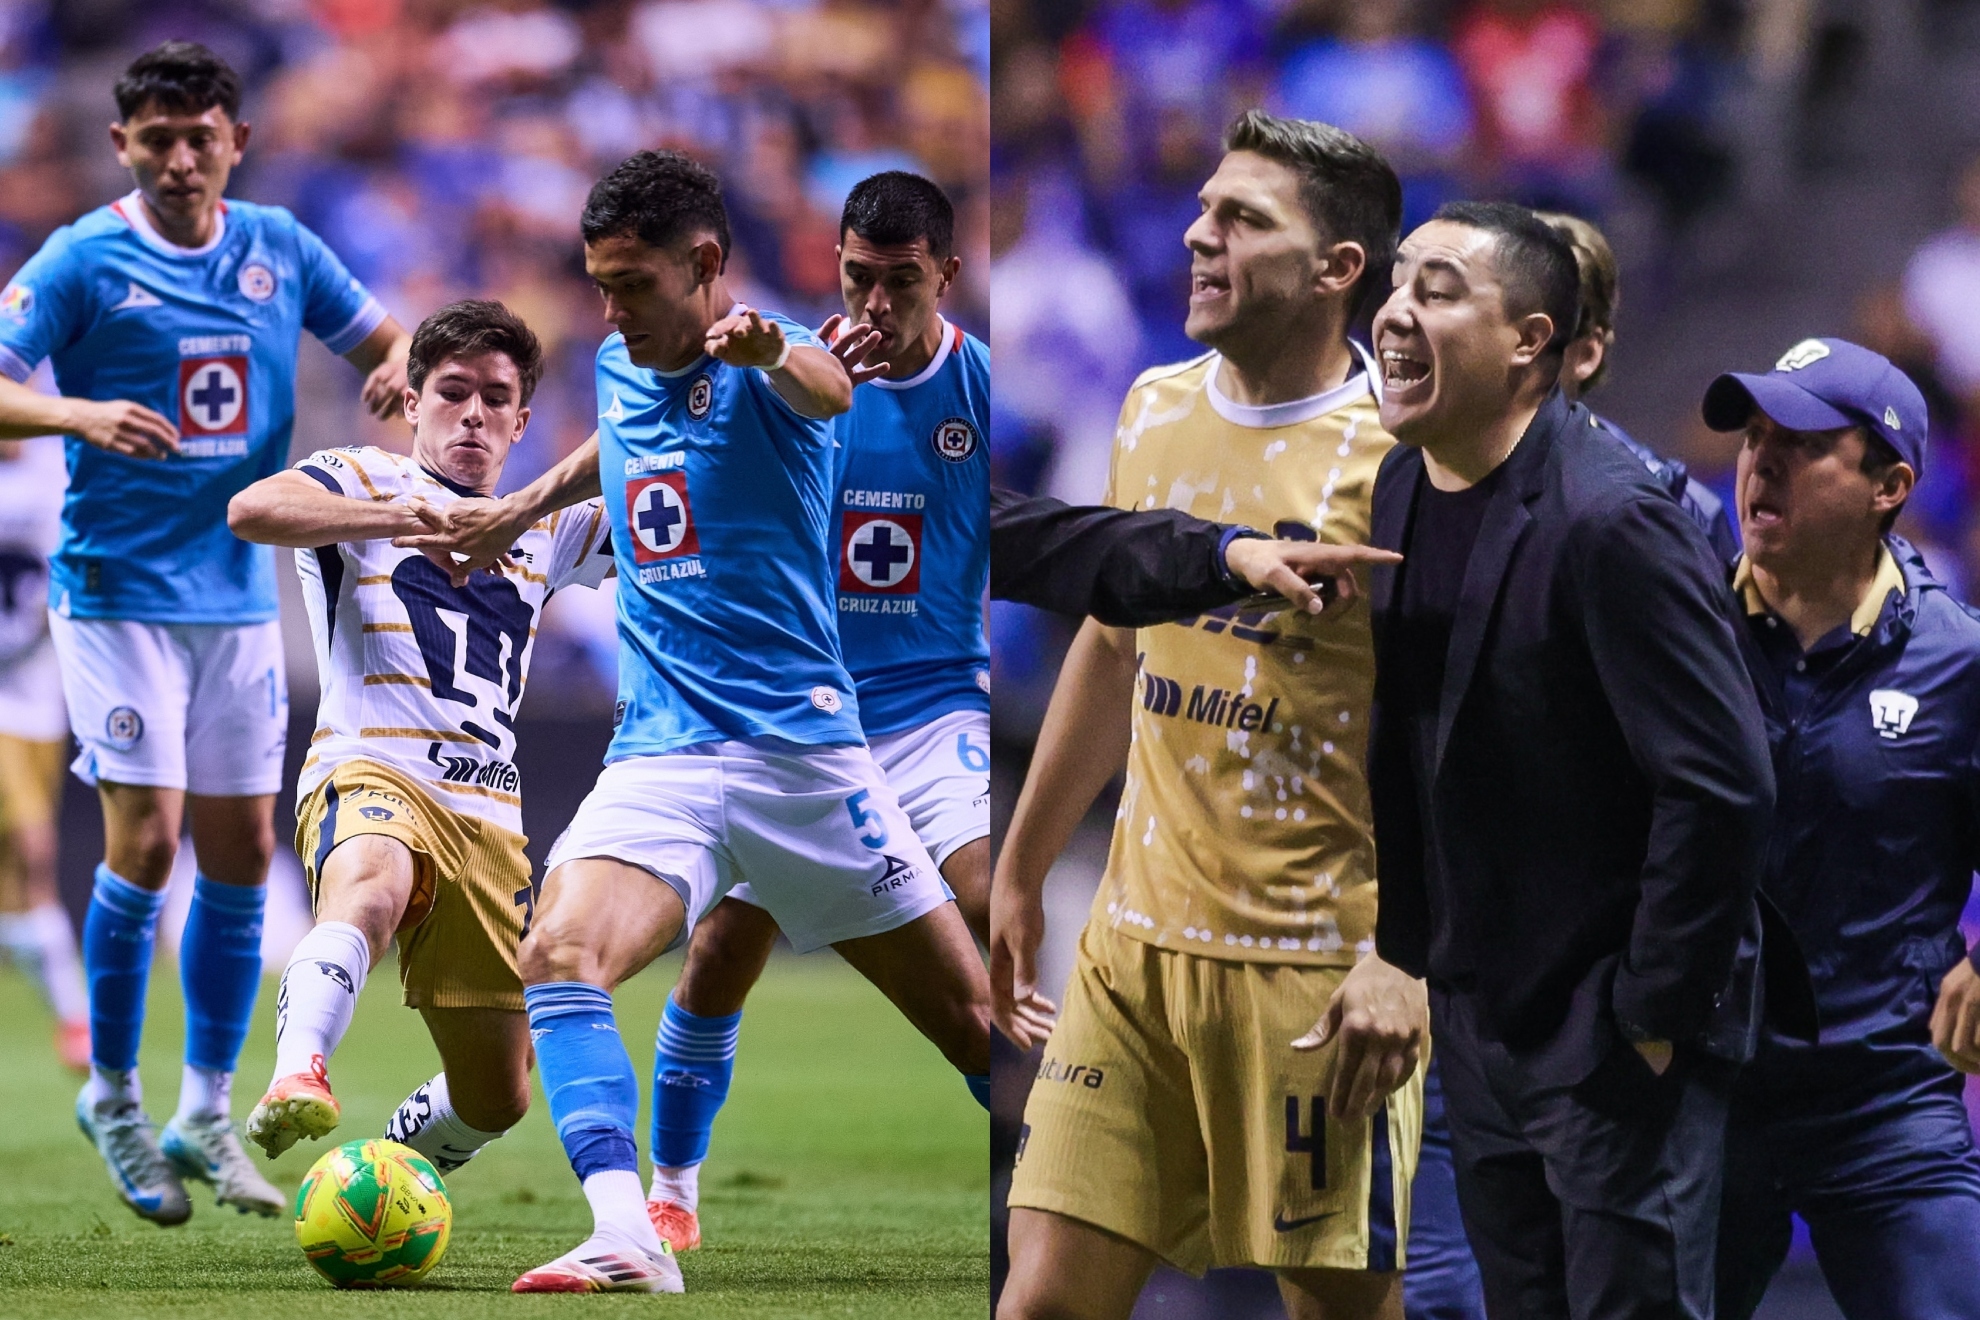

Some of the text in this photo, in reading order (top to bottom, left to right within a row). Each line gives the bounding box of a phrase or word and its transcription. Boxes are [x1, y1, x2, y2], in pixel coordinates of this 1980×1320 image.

[624, 450, 686, 476] CEMENTO
[843, 489, 925, 510] CEMENTO
[639, 559, 706, 586] CRUZ AZUL
[838, 597, 919, 615] CRUZ AZUL
[1186, 684, 1280, 734] Mifel
[957, 732, 990, 773] 6
[846, 788, 889, 850] 5
[871, 867, 924, 897] PIRMA
[1285, 1096, 1327, 1190] 4
